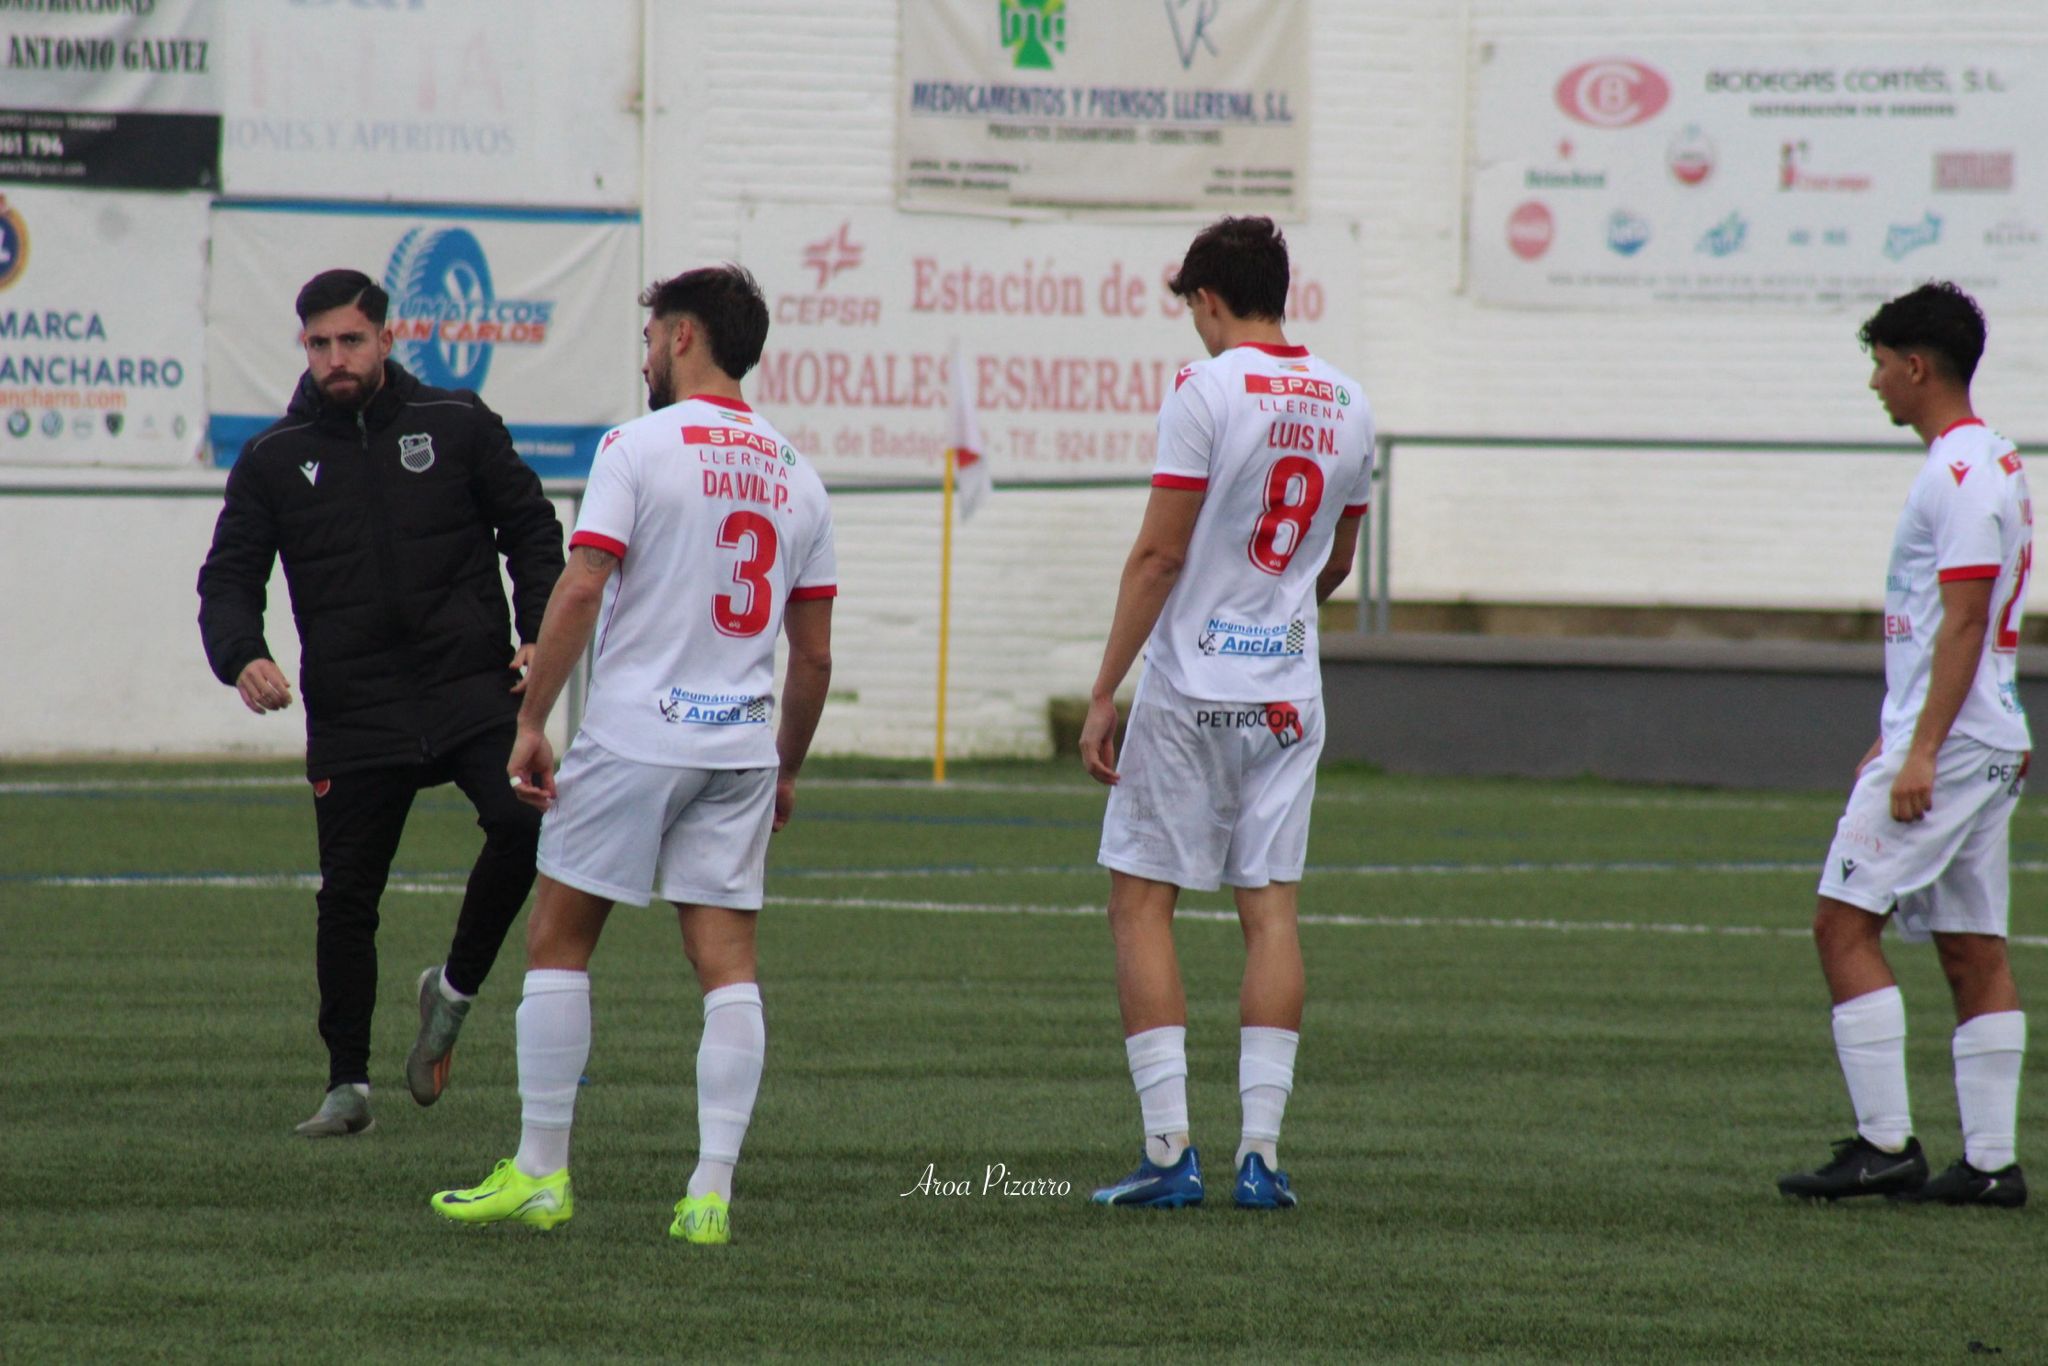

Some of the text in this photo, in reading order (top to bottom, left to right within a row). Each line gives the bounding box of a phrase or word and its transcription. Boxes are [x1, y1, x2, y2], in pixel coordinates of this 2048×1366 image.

[9, 35, 115, 72] ANTONIO
[121, 38, 210, 74] GALVEZ
[1705, 70, 1834, 93] BODEGAS
[911, 81, 1066, 118] MEDICAMENTOS
[1071, 87, 1082, 117] Y
[1088, 88, 1166, 119] PIENSOS
[912, 254, 1084, 316] Estación
[1101, 261, 1146, 318] de
[776, 295, 881, 327] CEPSA
[440, 320, 546, 344] CARLOS
[976, 354, 1178, 413] ESMERAL
[1269, 379, 1332, 400] SPAR
[1260, 399, 1344, 421] LLERENA
[709, 429, 776, 456] SPAR
[1268, 420, 1339, 456] LUIS N.
[699, 449, 788, 480] LLERENA
[773, 482, 793, 514] P.
[1246, 455, 1324, 576] 8
[711, 510, 777, 638] 3
[1208, 619, 1288, 636] Neumáticos
[1220, 636, 1283, 653] Ancla
[671, 687, 754, 704] Neumáticos
[684, 705, 741, 722] Ancla
[1197, 710, 1299, 729] PETROCOR
